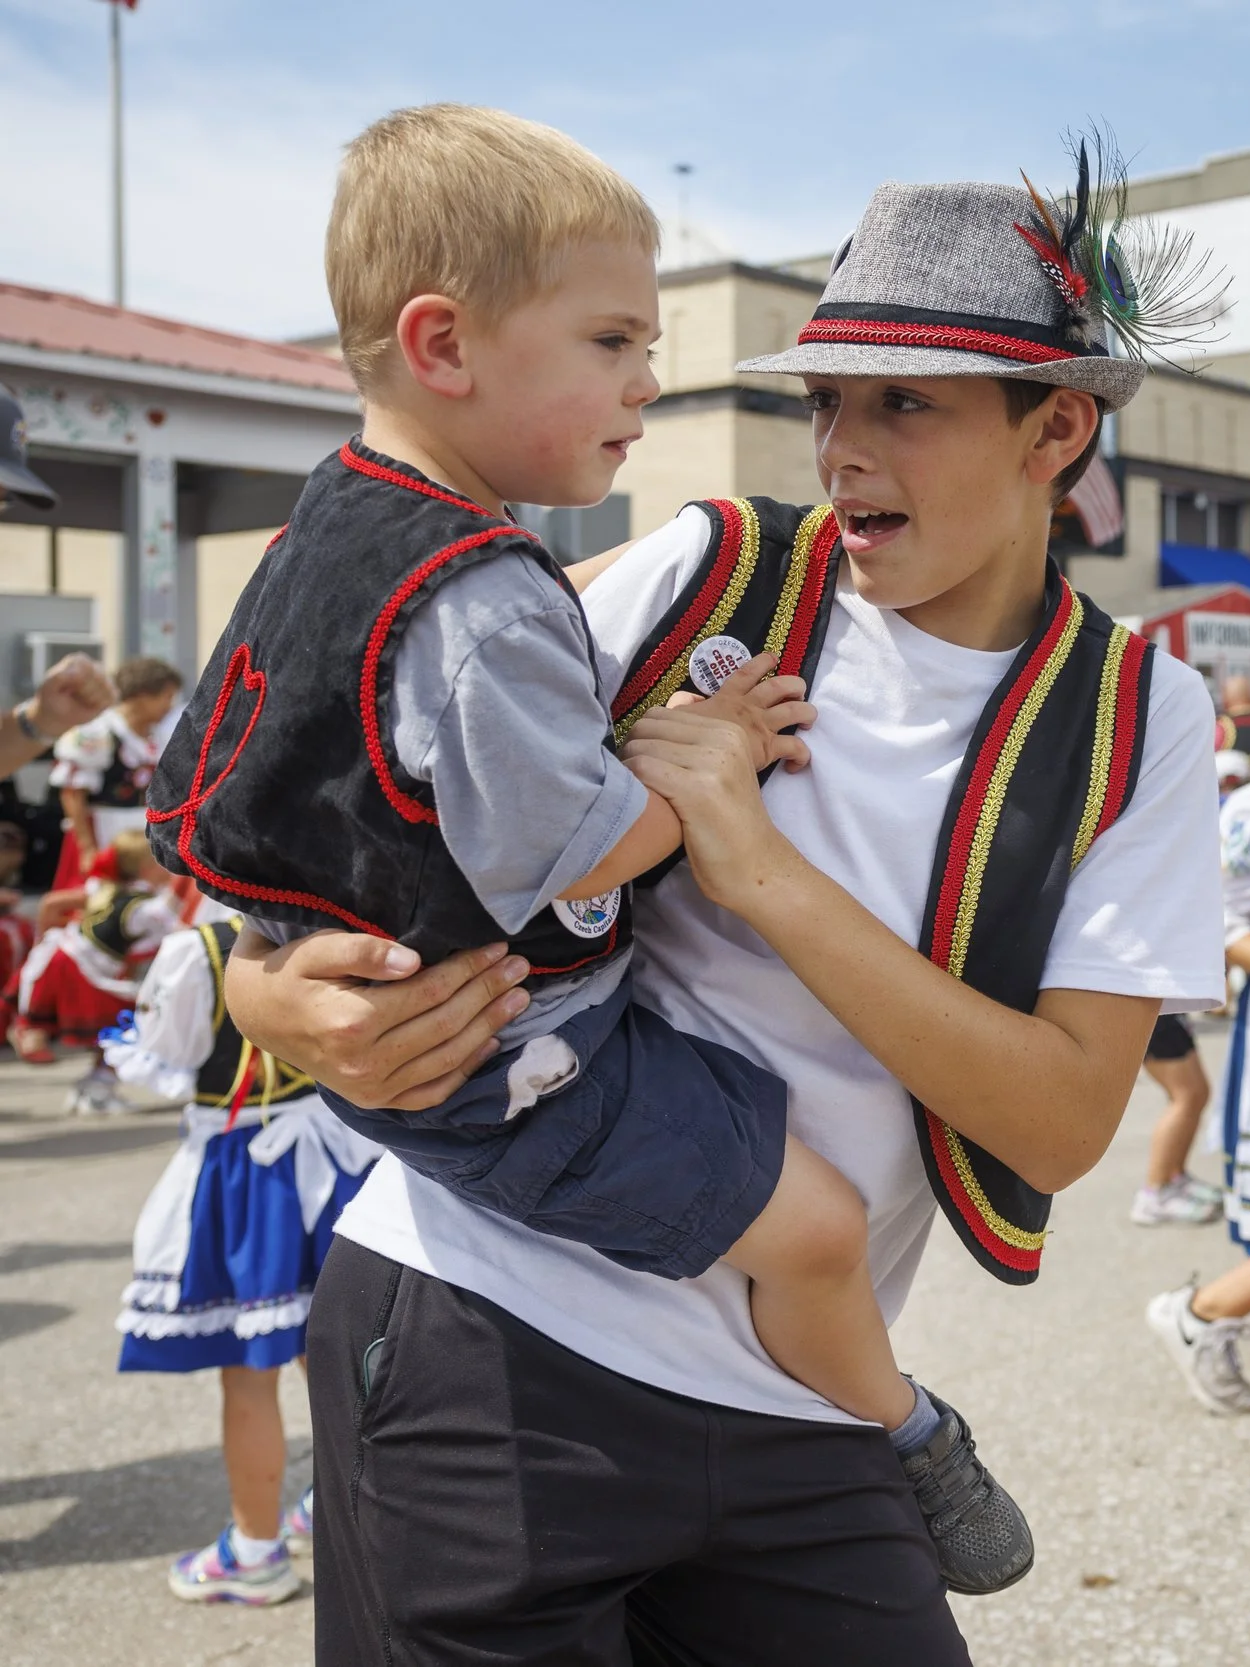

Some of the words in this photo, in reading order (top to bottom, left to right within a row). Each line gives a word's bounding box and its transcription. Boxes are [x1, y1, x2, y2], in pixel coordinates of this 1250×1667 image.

[718, 640, 740, 651] CZECH
[712, 649, 732, 677] CZECH
[725, 654, 739, 671] GOT
[710, 663, 724, 680] OUT
[573, 920, 592, 934] Czech
[593, 914, 613, 934] Capital
[611, 905, 617, 916] of
